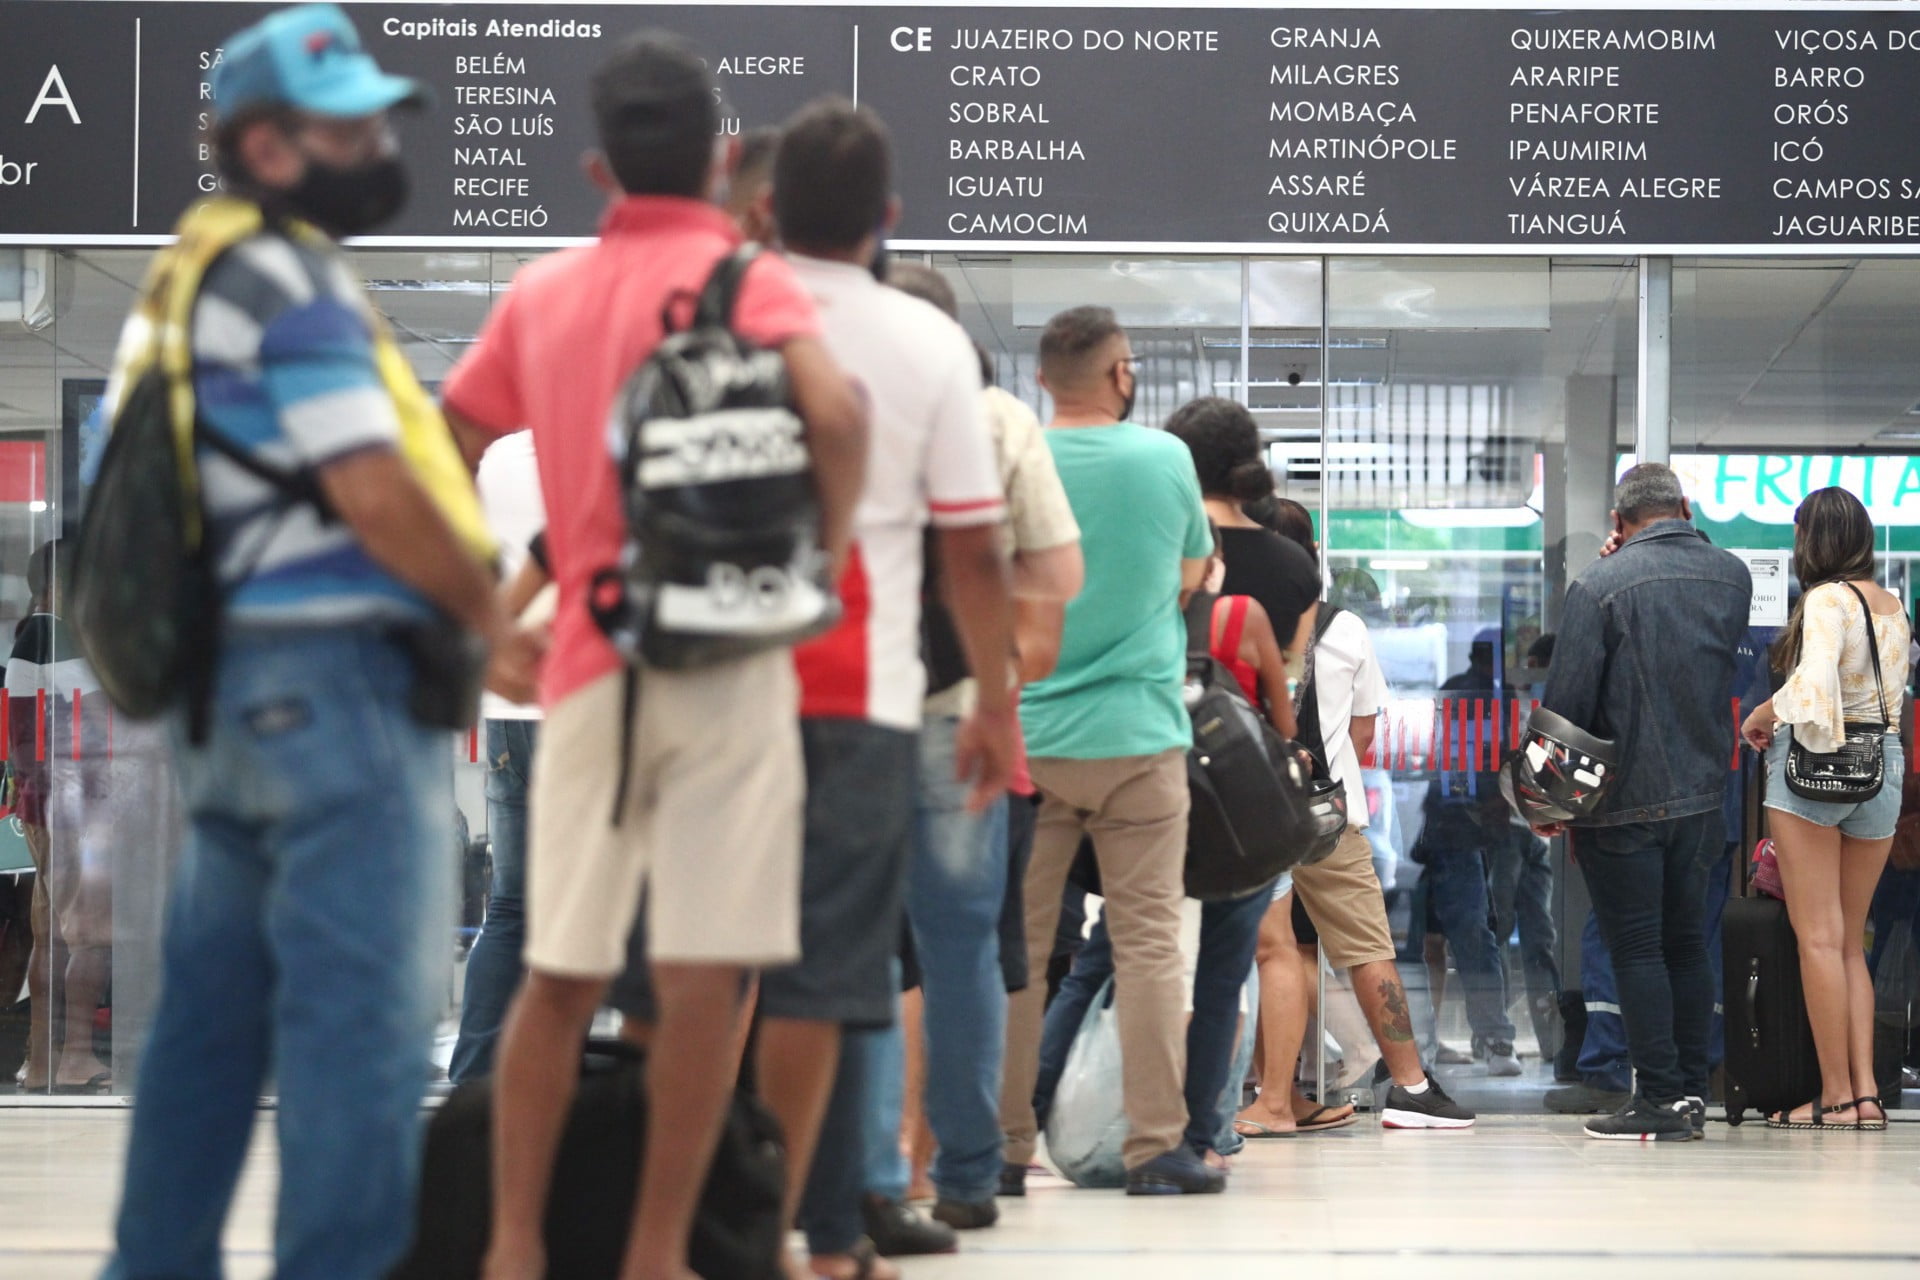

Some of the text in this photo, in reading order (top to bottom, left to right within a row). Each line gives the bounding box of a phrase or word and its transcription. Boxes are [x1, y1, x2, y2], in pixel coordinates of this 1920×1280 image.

[382, 17, 602, 41] Capitais Atendidas
[889, 25, 933, 53] CE
[949, 28, 1219, 52] JUAZEIRO DO NORTE
[1270, 26, 1382, 49] GRANJA
[1510, 28, 1716, 51] QUIXERAMOBIM
[1774, 29, 1879, 55] VIÇOSA
[199, 47, 225, 70] SÃ
[455, 51, 526, 75] BELÉM
[715, 55, 805, 76] ALEGRE
[949, 64, 1041, 88] CRATO
[1269, 63, 1400, 86] MILAGRES
[1509, 65, 1620, 87] ARARIPE
[1774, 66, 1865, 88] BARRO
[24, 63, 82, 125] A
[454, 86, 557, 106] TERESINA
[948, 101, 1051, 124] SOBRAL
[1269, 100, 1417, 128] MOMBAÇA
[1510, 102, 1659, 125] PENAFORTE
[1773, 98, 1849, 125] ORÓS
[453, 112, 554, 137] SÃO LUÍS
[454, 147, 527, 167] NATAL
[949, 138, 1086, 161] BARBALHA
[1268, 133, 1457, 160] MARTINÓPOLE
[1509, 139, 1647, 161] IPAUMIRIM
[1773, 135, 1824, 162] ICÓ
[453, 177, 530, 197] RECIFE
[948, 175, 1043, 198] IGUATU
[1267, 171, 1366, 197] ASSARÉ
[1508, 172, 1721, 199] VÁRZEA ALEGRE
[1772, 177, 1891, 200] CAMPOS
[452, 204, 549, 228] MACEIÓ
[947, 212, 1088, 235] CAMOCIM
[1267, 207, 1391, 235] QUIXADÁ
[1507, 208, 1627, 236] TIANGUÁ
[1772, 214, 1920, 237] JAGUARIBE
[1752, 592, 1777, 603] ÓRIO
